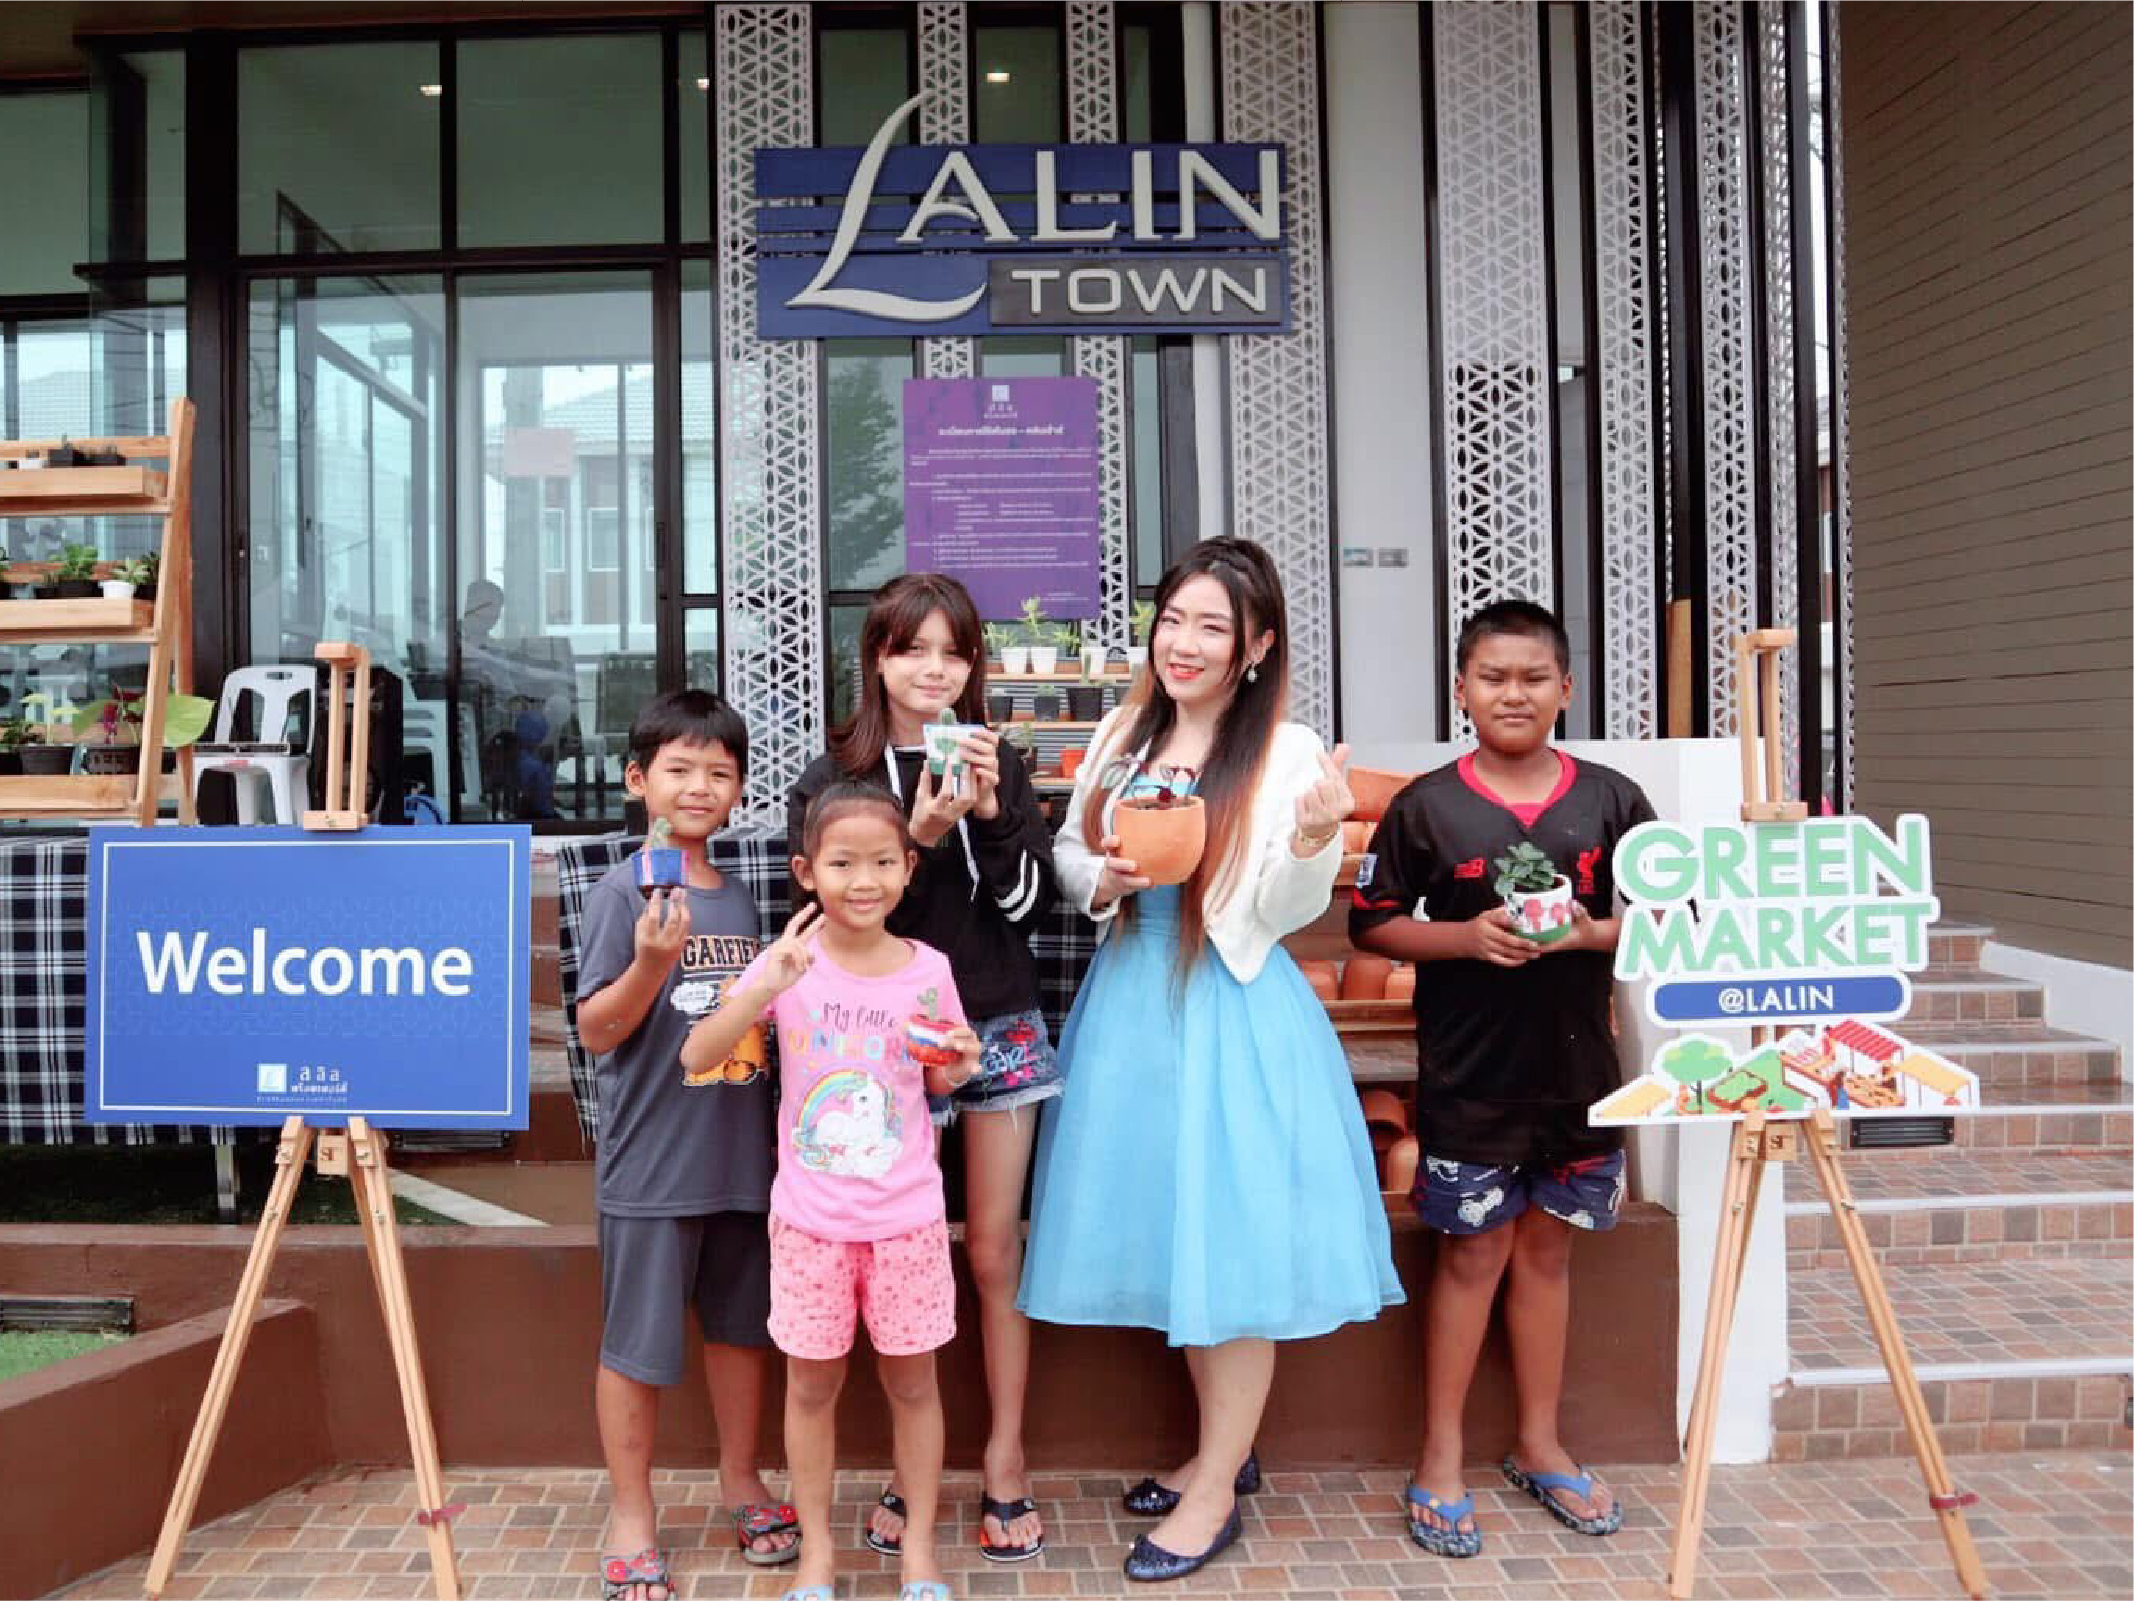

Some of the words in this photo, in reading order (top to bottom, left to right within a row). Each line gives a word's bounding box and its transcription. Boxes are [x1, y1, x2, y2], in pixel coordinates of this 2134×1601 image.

[786, 90, 1281, 321] LALIN
[1012, 267, 1267, 315] TOWN
[1620, 821, 1924, 901] GREEN
[136, 927, 474, 996] Welcome
[1623, 903, 1931, 974] MARKET
[1718, 984, 1835, 1014] @LALIN
